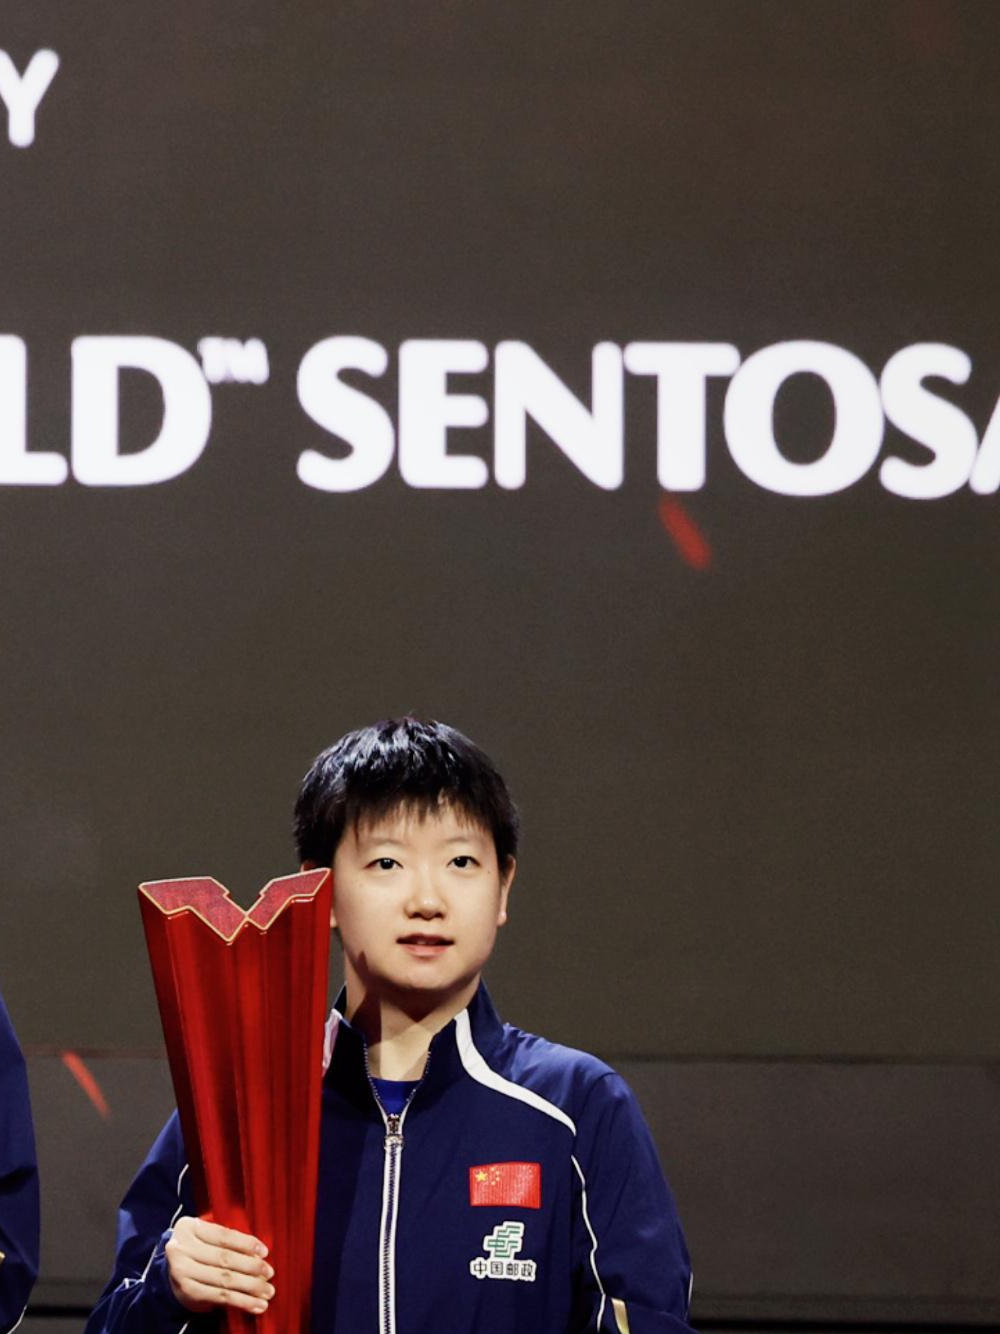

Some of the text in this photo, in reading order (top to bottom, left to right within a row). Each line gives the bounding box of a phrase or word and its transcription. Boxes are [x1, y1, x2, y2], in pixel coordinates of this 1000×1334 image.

[296, 335, 1000, 500] SENTOS
[473, 1259, 534, 1278] 中国邮政
